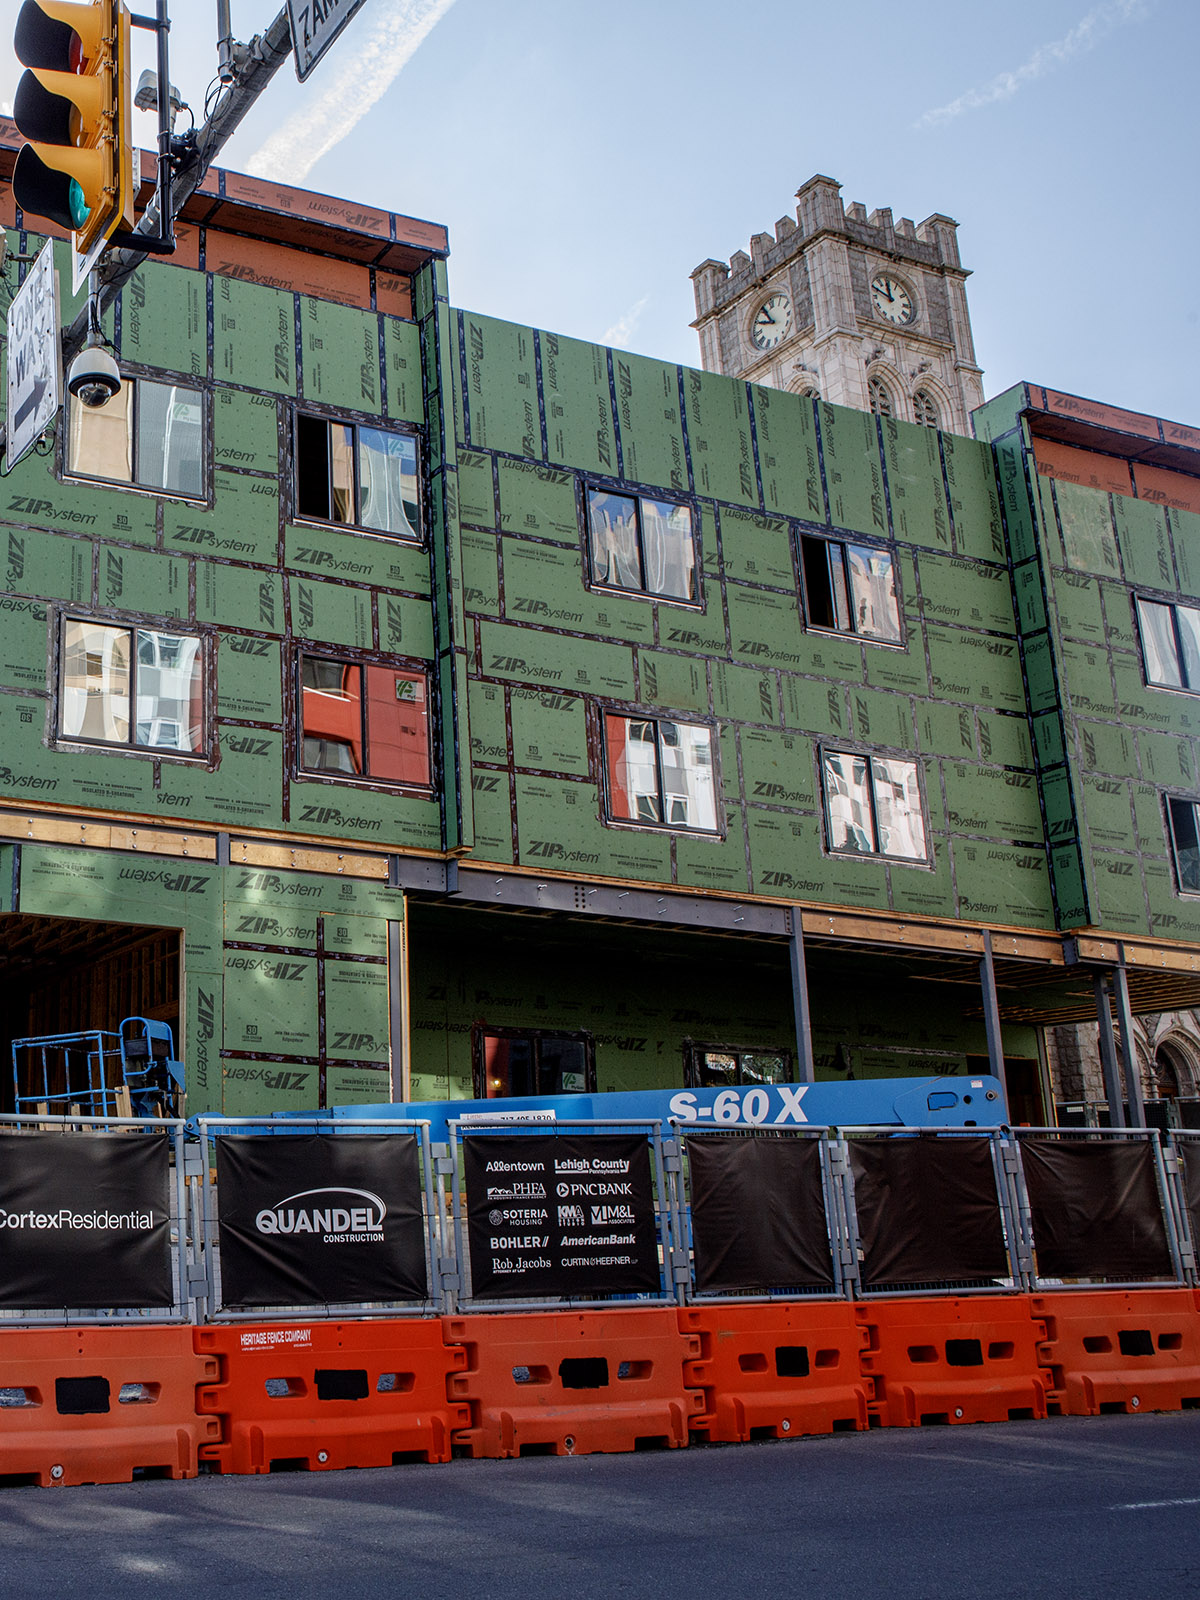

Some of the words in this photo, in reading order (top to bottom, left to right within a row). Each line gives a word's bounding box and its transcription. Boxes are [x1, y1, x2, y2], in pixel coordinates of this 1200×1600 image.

[486, 1160, 545, 1172] Allentown
[555, 1159, 589, 1171] Lehigh
[592, 1159, 630, 1173] County
[513, 1182, 546, 1195] PHFA
[503, 1209, 548, 1219] SOTERIA
[256, 1208, 383, 1234] QUANDEL
[323, 1233, 385, 1243] CONSTRUCTION
[492, 1258, 513, 1270] Rob
[516, 1257, 551, 1269] Jacobs
[240, 1332, 266, 1346] HERITAGE
[267, 1330, 284, 1344] FENCE
[285, 1329, 311, 1342] COMPANY
